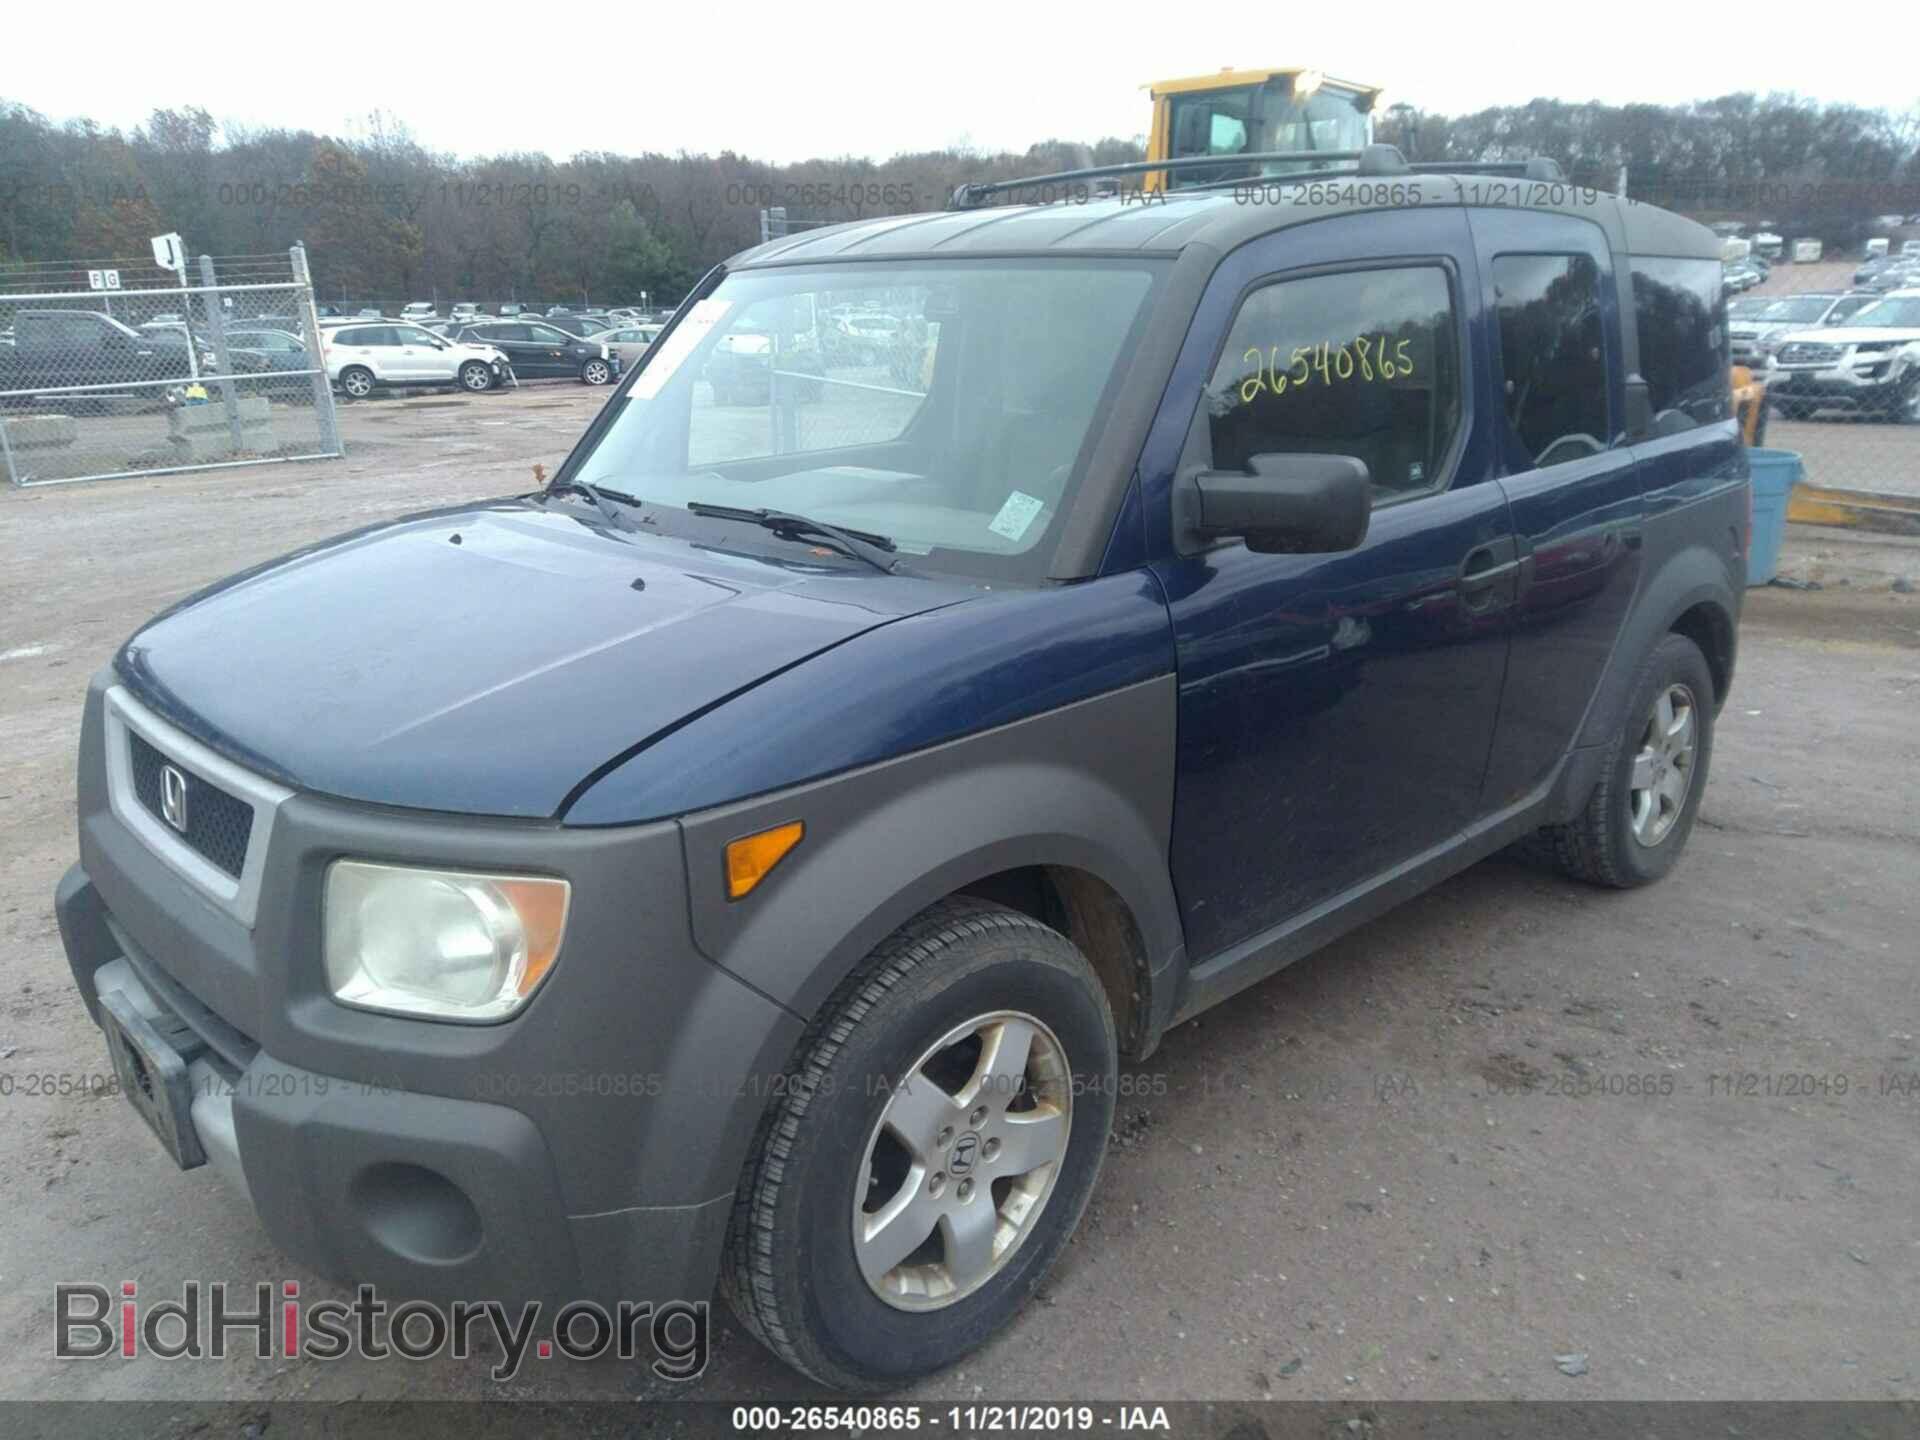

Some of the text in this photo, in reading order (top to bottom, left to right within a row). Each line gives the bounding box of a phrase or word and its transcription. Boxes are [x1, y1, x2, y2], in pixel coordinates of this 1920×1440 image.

[165, 238, 175, 265] J
[92, 274, 118, 286] F G
[1241, 336, 1414, 402] 26540865
